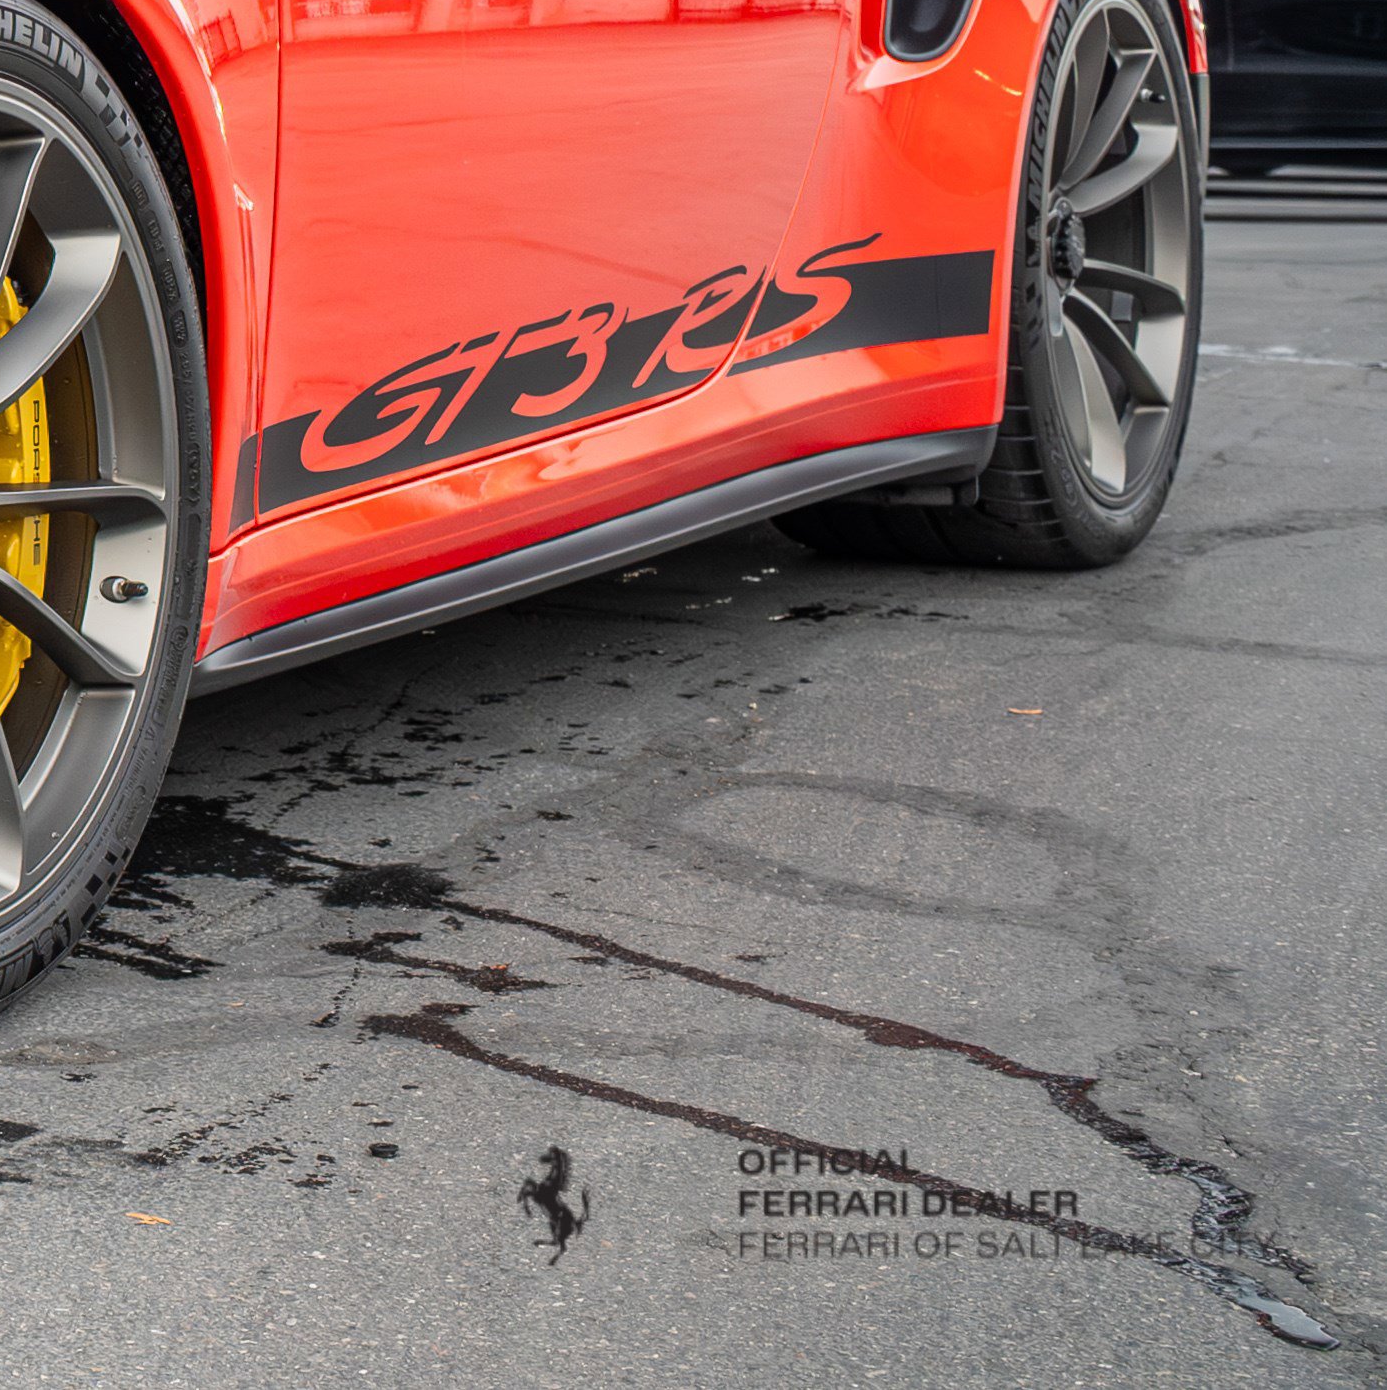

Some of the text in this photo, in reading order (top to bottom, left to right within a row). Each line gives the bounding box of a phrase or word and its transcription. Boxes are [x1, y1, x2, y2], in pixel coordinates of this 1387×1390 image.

[1028, 6, 1072, 210] MICHELIN
[300, 302, 627, 473] GT3
[633, 232, 883, 388] RS
